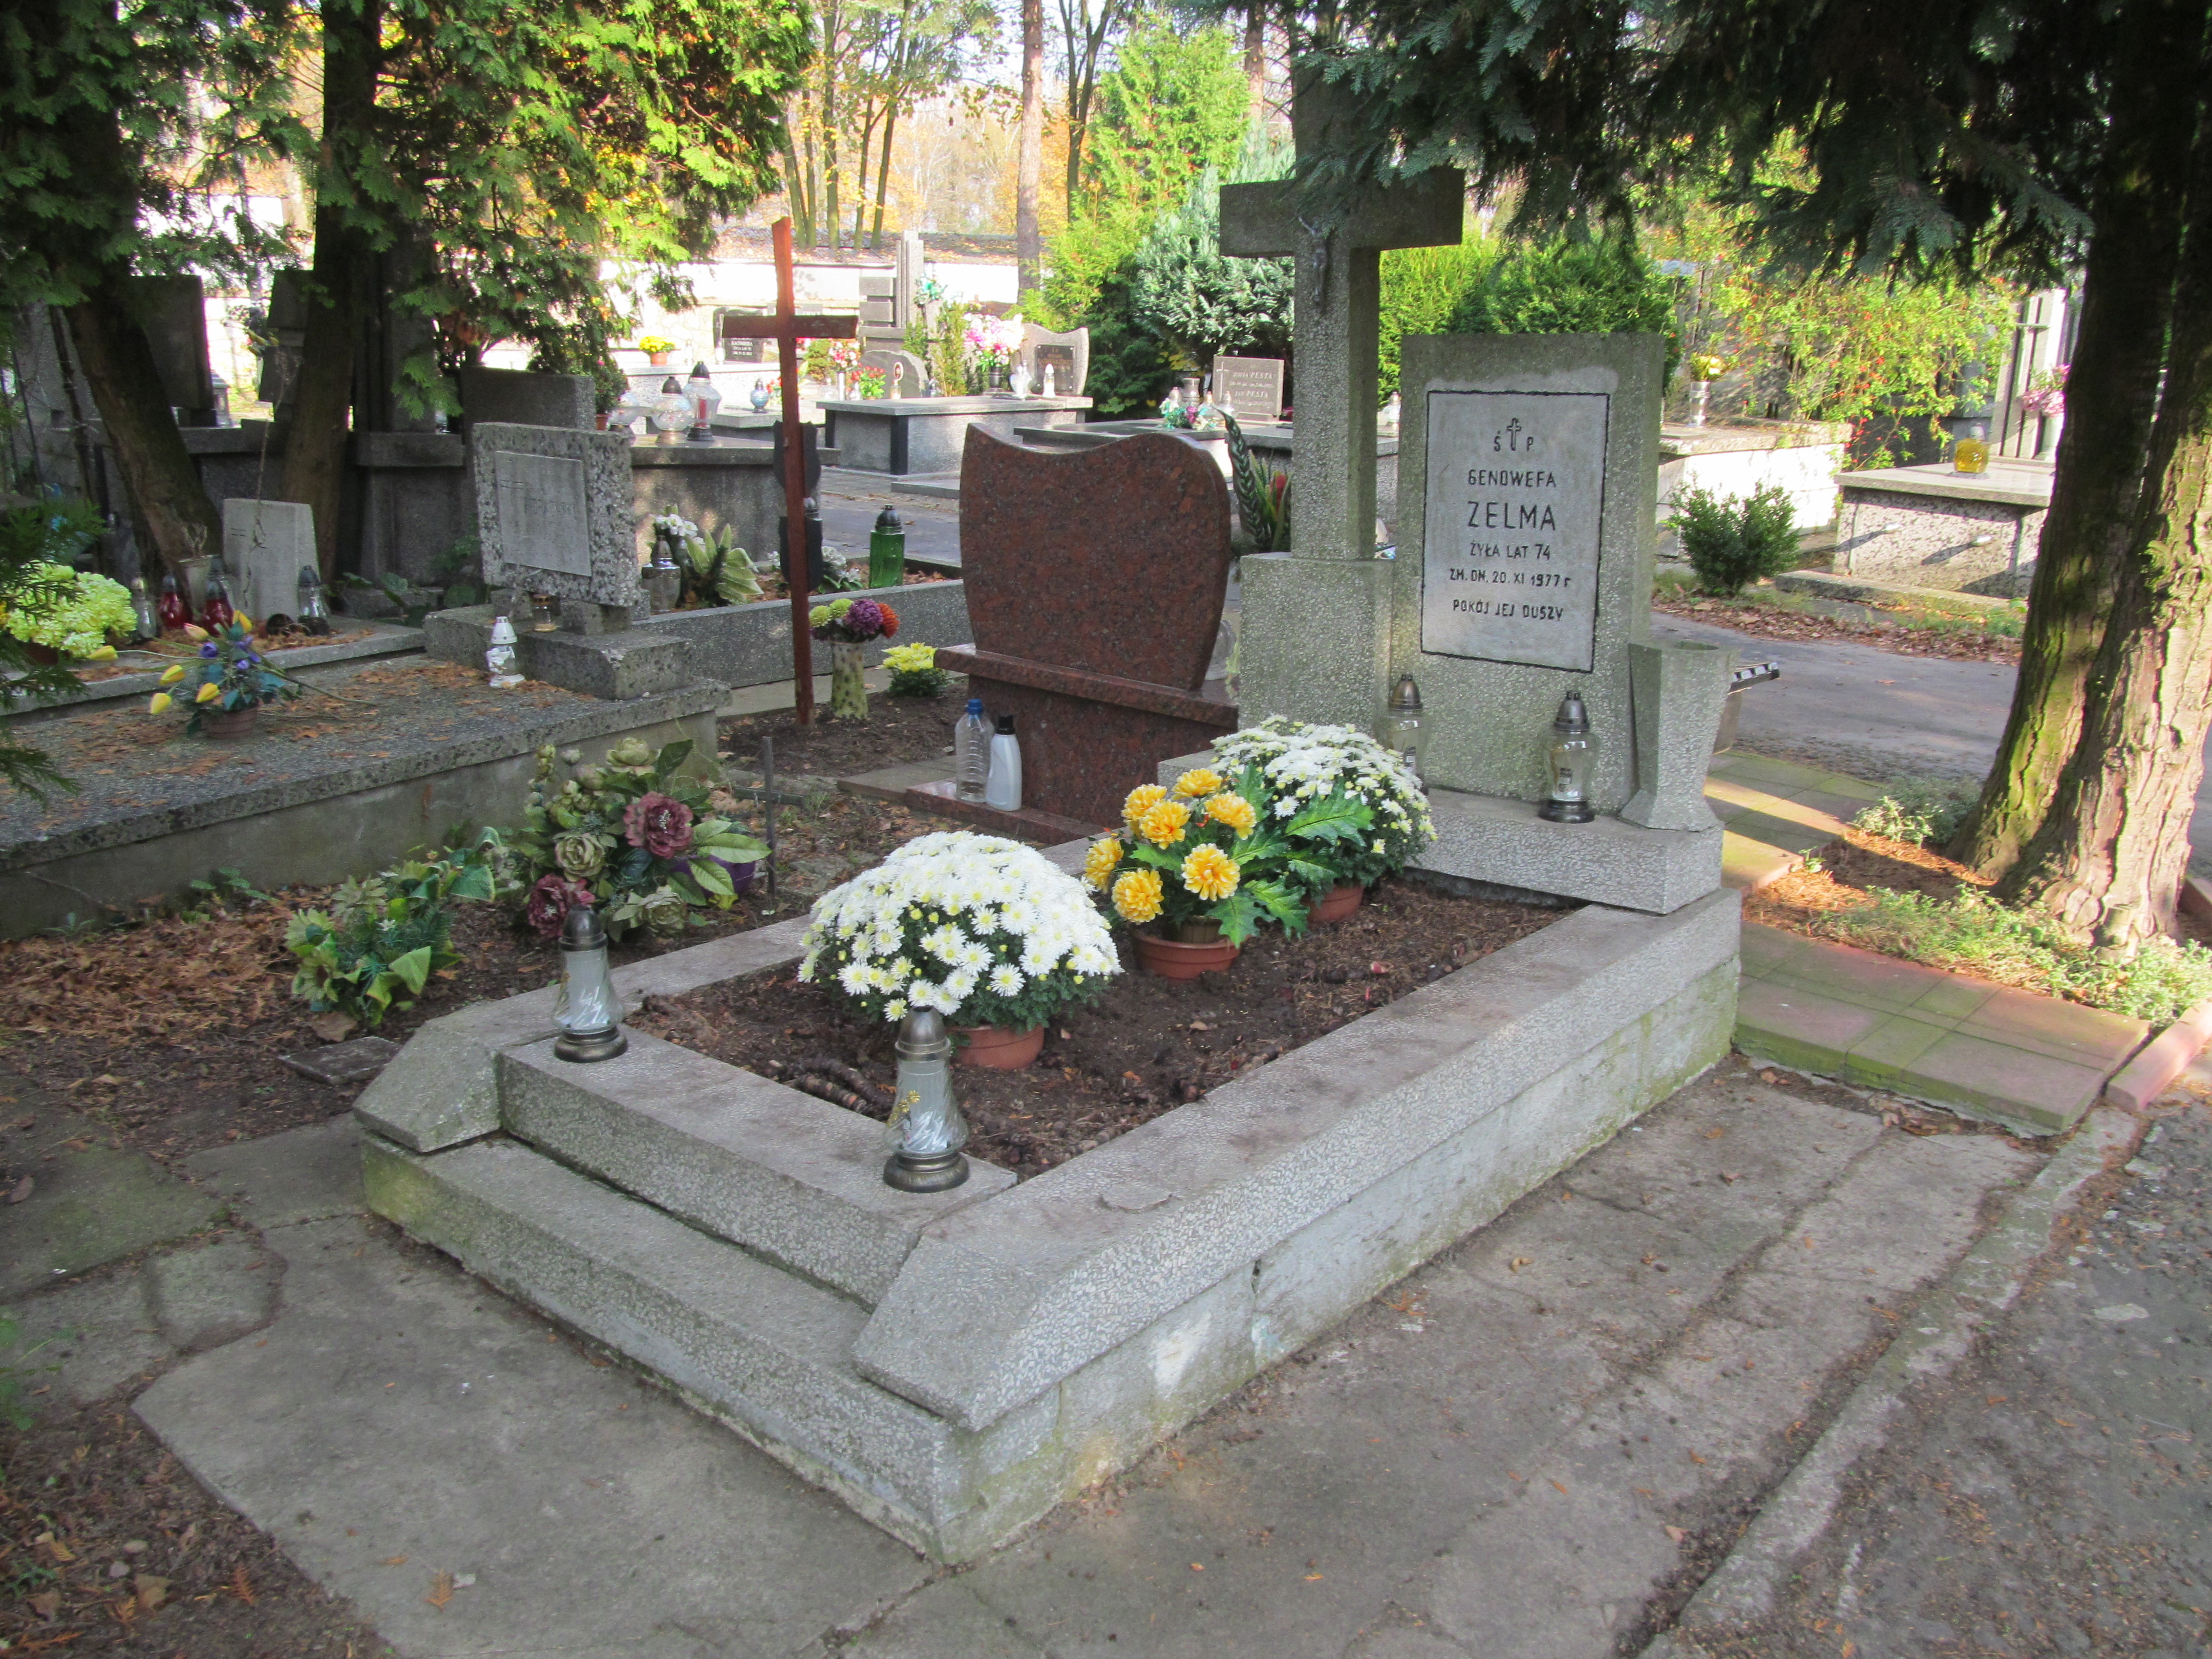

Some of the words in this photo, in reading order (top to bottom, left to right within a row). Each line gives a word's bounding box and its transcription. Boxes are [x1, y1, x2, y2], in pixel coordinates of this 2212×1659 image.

[1468, 469, 1557, 487] GENOWEFA
[1467, 501, 1556, 530] ZELMA
[1470, 540, 1500, 557] ŻYŁA
[1507, 545, 1528, 559] LAT
[1535, 543, 1550, 560] 74
[1514, 572, 1525, 584] XI
[1530, 573, 1561, 587] 1977
[1453, 599, 1490, 614] POKÓJ
[1495, 603, 1515, 616] JEJ
[1523, 604, 1564, 621] DUSZY
